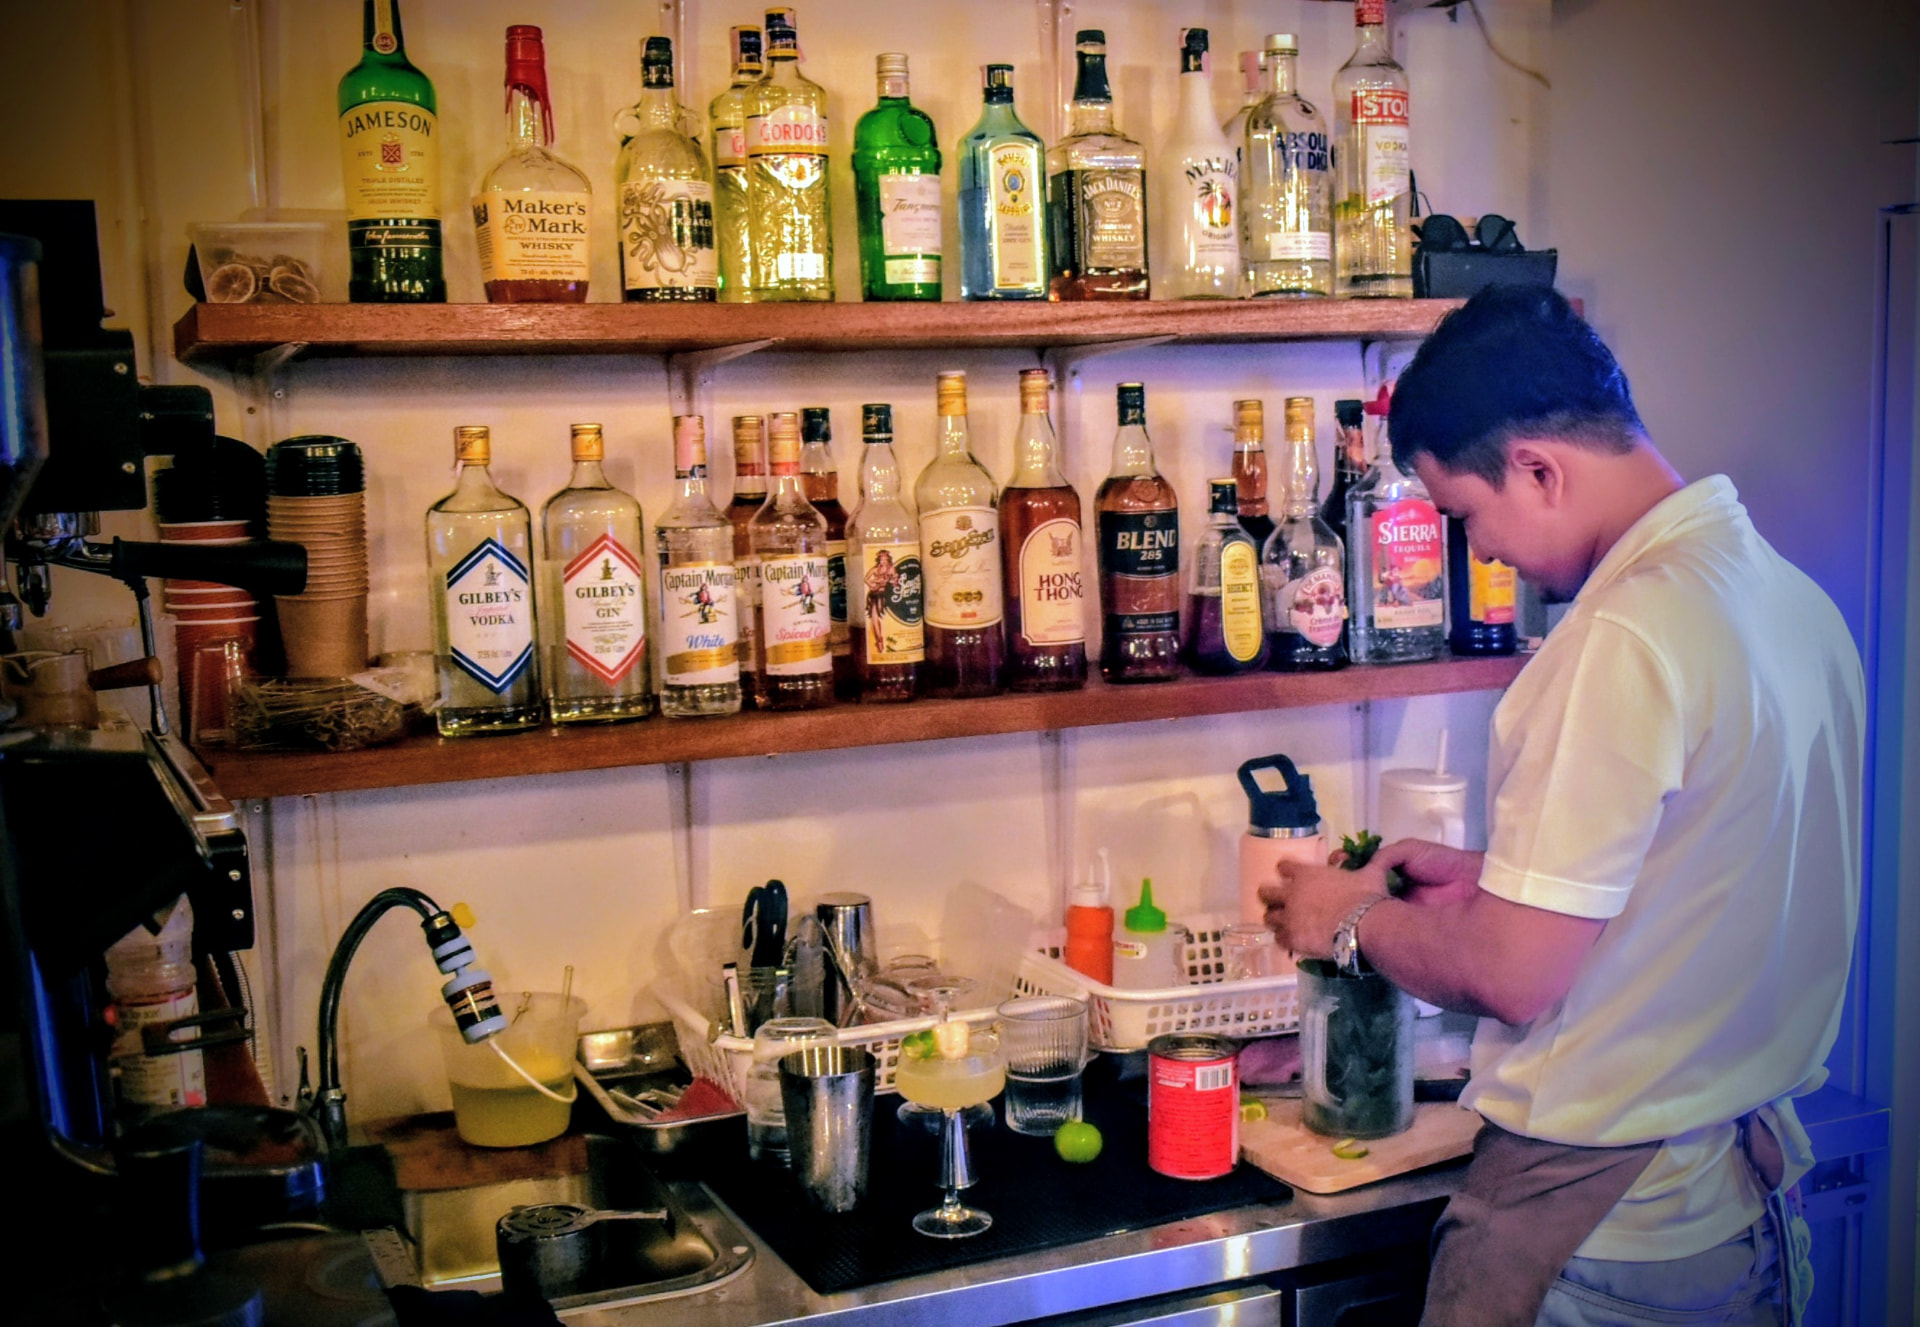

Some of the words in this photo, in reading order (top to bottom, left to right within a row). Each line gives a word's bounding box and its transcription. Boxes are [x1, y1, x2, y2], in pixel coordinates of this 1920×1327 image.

[347, 111, 432, 138] JAMESON
[1083, 181, 1106, 200] JACK
[503, 199, 586, 216] Maker's
[526, 217, 586, 234] Mark
[520, 242, 574, 250] WHISKY
[1092, 234, 1136, 242] WHISKEY
[1116, 529, 1177, 550] BLEND
[1378, 519, 1438, 545] SIERRA
[1140, 550, 1163, 561] 285
[664, 570, 704, 591] Captain
[764, 562, 804, 583] Captain
[1039, 571, 1082, 588] HONG
[459, 588, 522, 605] GILBEY'S
[575, 582, 635, 599] GILBEY'S
[1033, 585, 1084, 602] THONG
[470, 614, 515, 626] VODKA
[596, 607, 621, 618] GIN
[686, 634, 726, 649] White
[776, 628, 812, 641] Spiced
